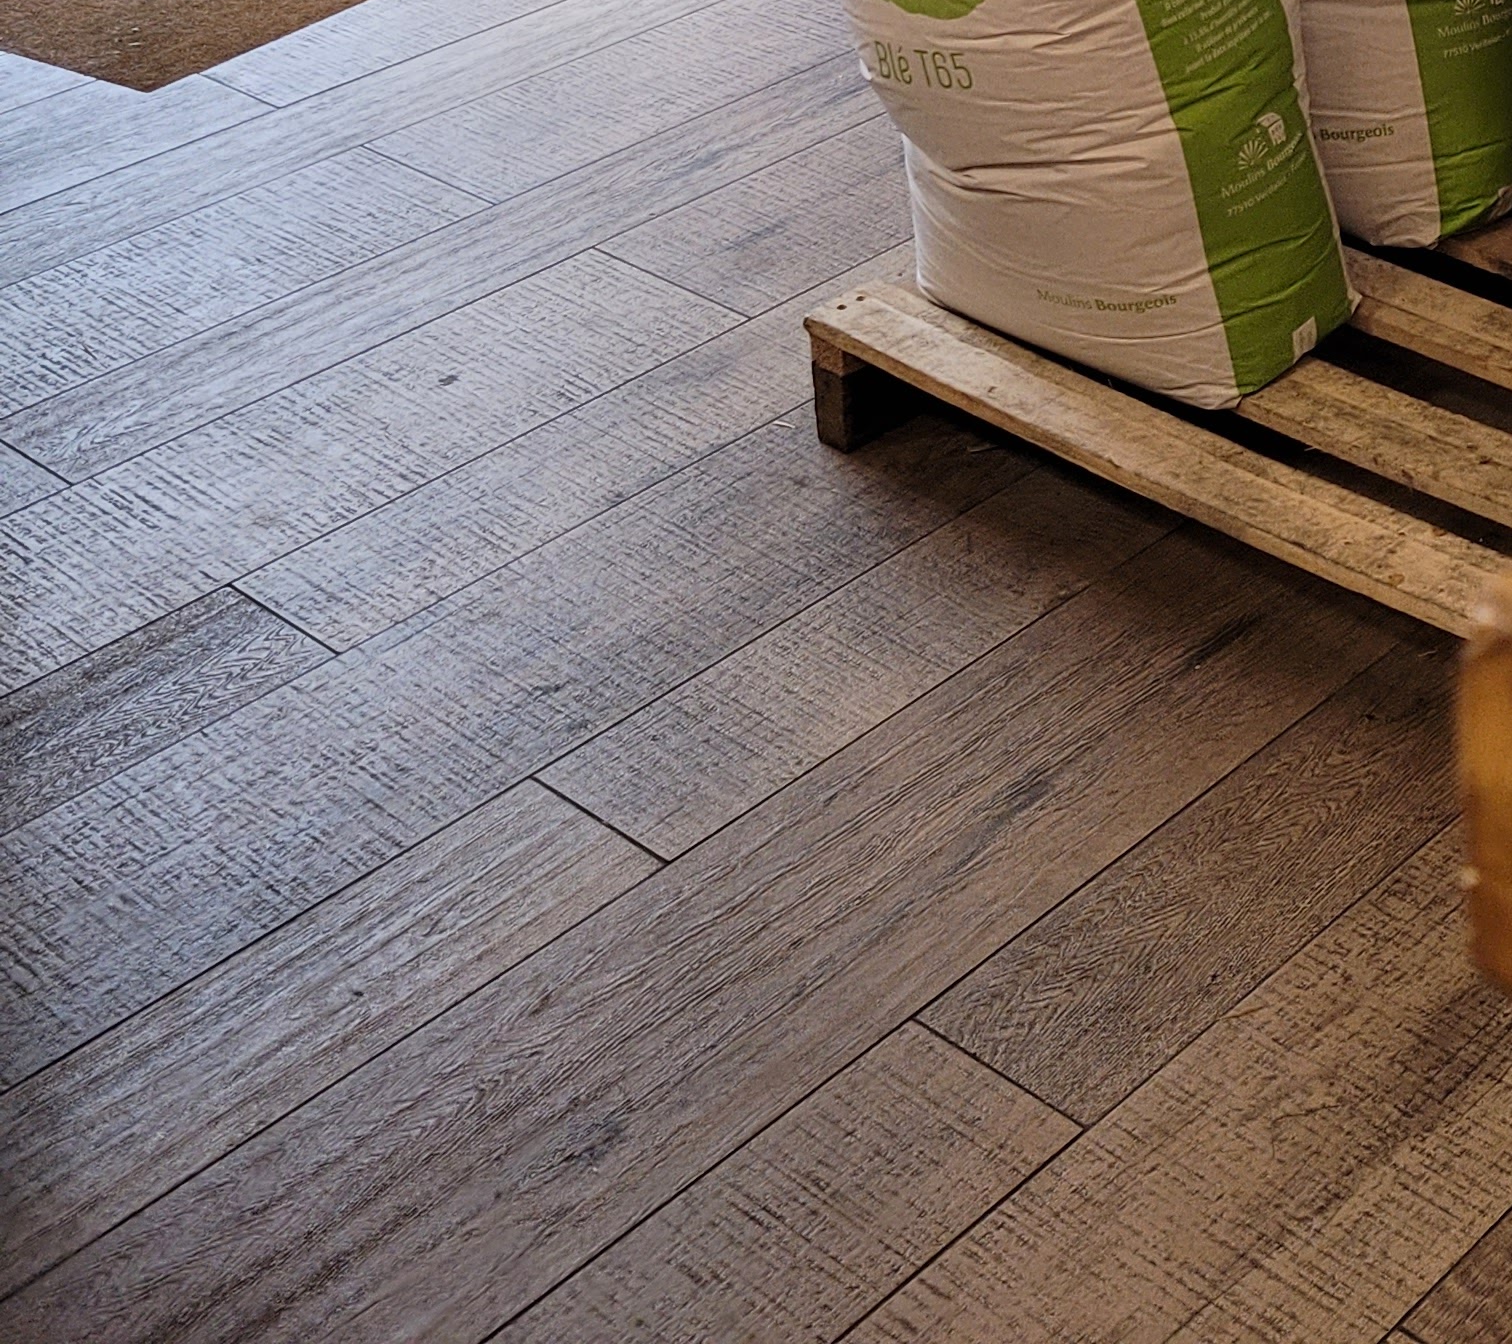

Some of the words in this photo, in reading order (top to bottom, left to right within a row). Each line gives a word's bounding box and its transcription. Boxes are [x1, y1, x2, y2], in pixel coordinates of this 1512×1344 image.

[874, 40, 913, 85] Blé
[913, 49, 973, 90] T65
[1320, 123, 1395, 142] Bourgeois
[1036, 288, 1093, 310] Moulins
[1094, 294, 1177, 314] Bourgeois
